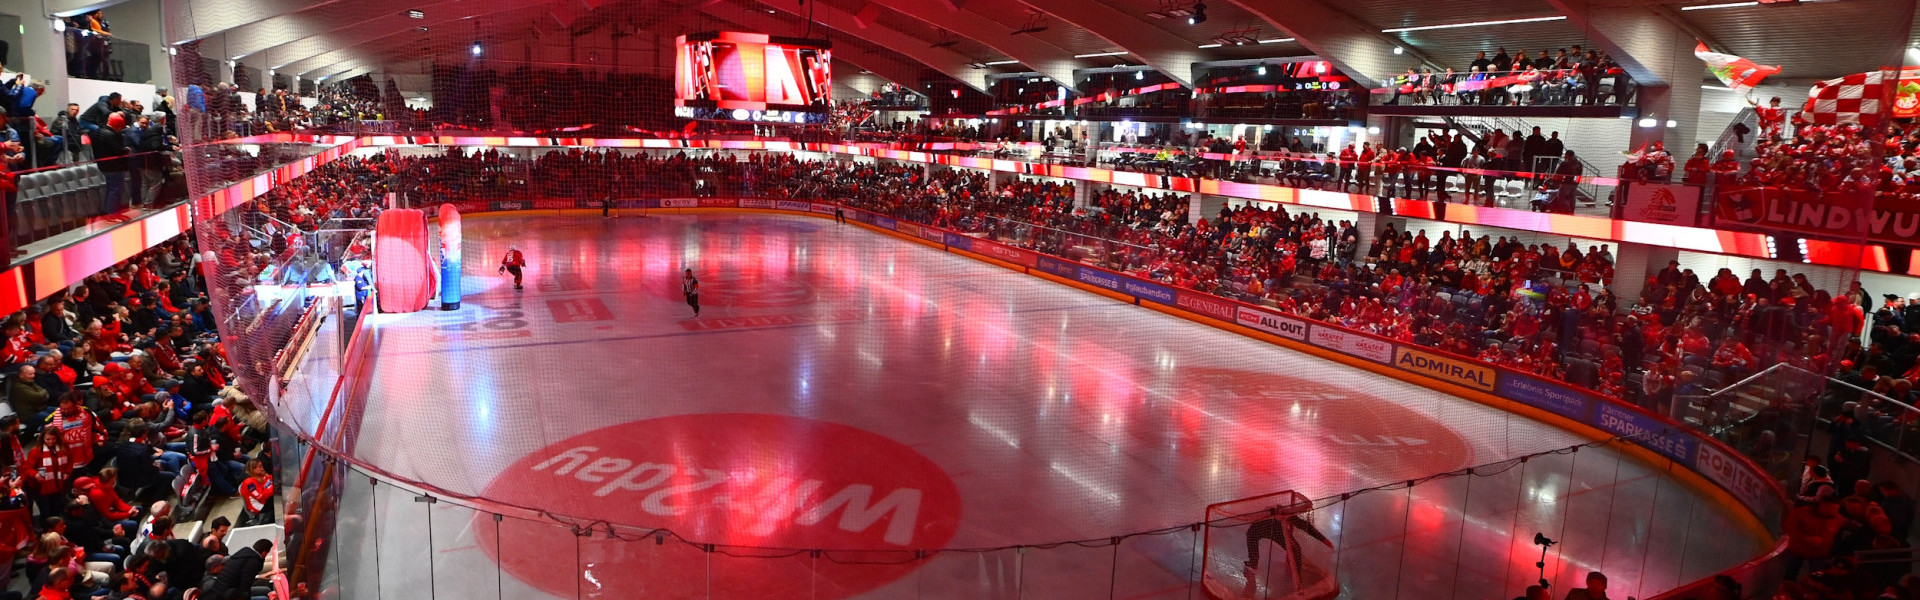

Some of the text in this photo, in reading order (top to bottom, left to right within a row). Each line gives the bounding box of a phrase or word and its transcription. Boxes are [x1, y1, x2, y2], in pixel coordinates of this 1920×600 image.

[1080, 272, 1112, 288] SPARKASSE
[1190, 297, 1234, 319] GENERALI
[1261, 316, 1279, 330] ALL
[1280, 322, 1304, 337] OUT.
[1400, 352, 1491, 388] ADMIRAL
[1545, 388, 1583, 407] Sportpark
[1601, 413, 1674, 453] SPARKASSE
